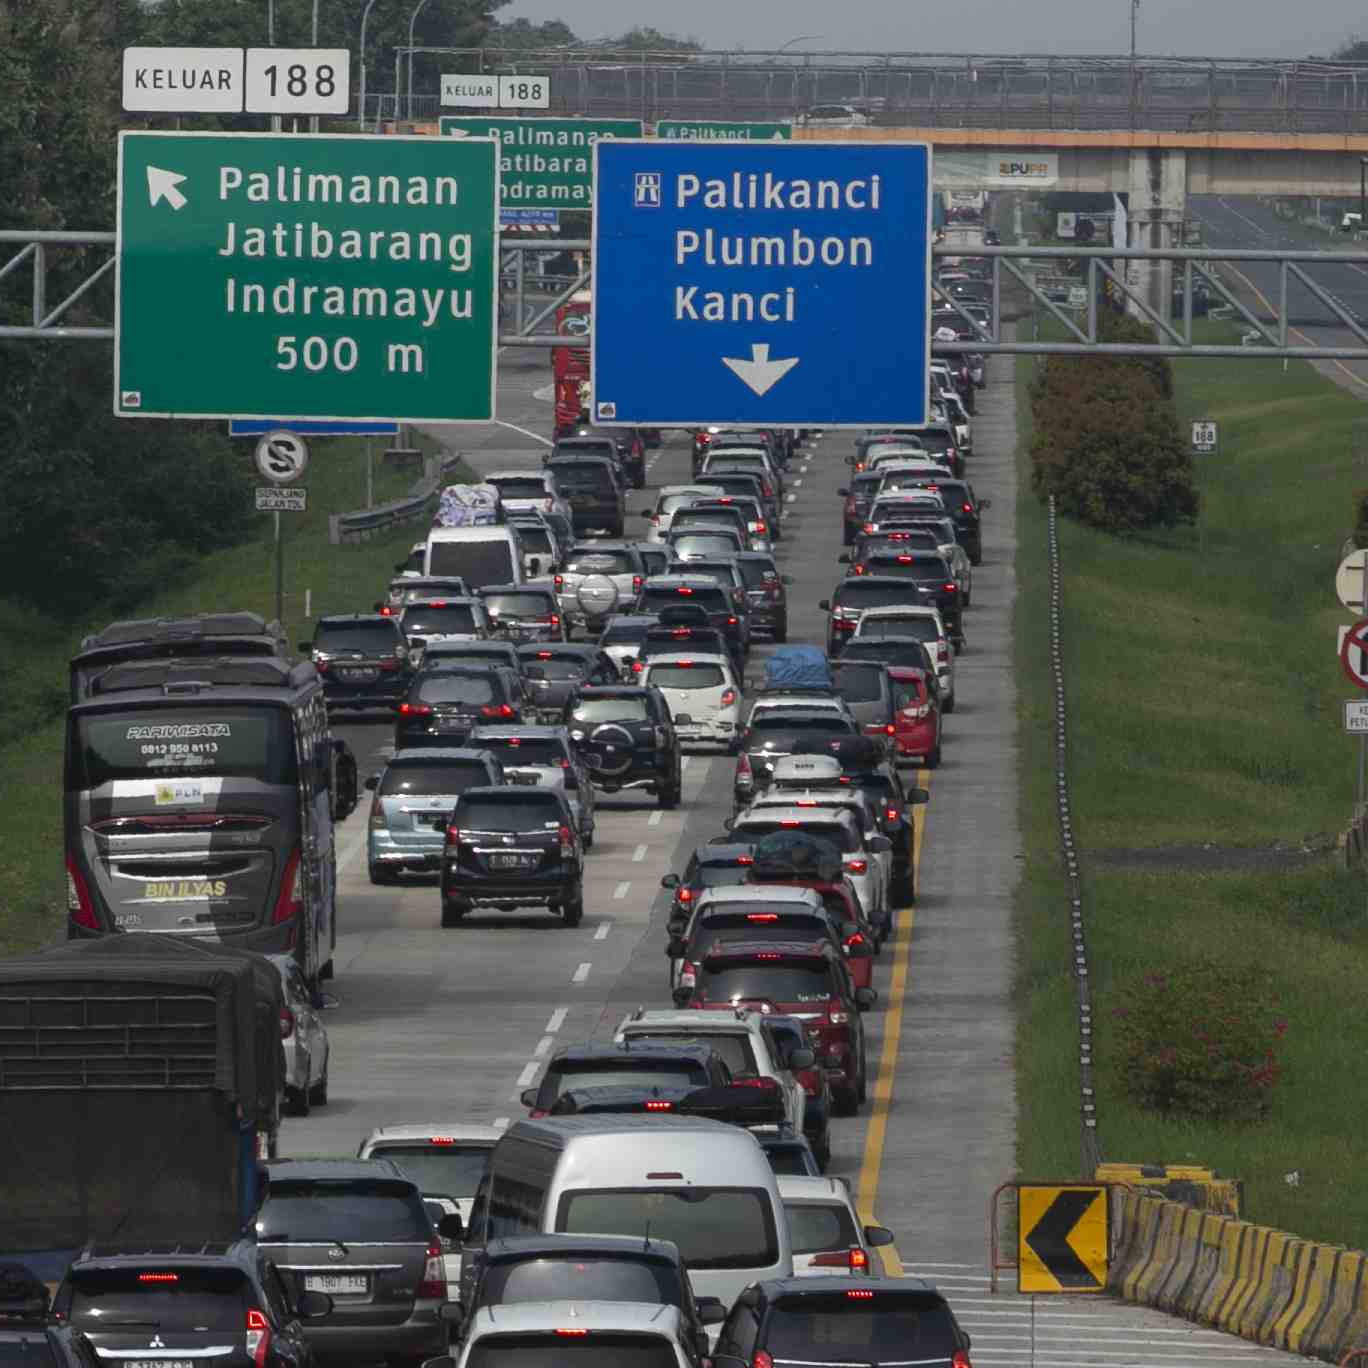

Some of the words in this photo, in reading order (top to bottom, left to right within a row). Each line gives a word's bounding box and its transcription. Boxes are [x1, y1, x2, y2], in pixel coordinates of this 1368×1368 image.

[135, 69, 232, 90] KELUAR
[264, 64, 336, 97] 188
[446, 85, 493, 97] KELUAR
[508, 83, 543, 100] 188
[219, 165, 458, 205] Palimanan
[676, 172, 881, 209] Palikanci
[218, 222, 473, 272] Jatibarang
[675, 228, 873, 266] Plumbon
[226, 277, 473, 327] Indramayu
[674, 286, 795, 321] Kanci
[276, 335, 359, 371] 500
[387, 342, 424, 373] m
[126, 723, 232, 740] PARIWISATA
[145, 882, 175, 897] BIN
[178, 880, 227, 897] ILYAS
